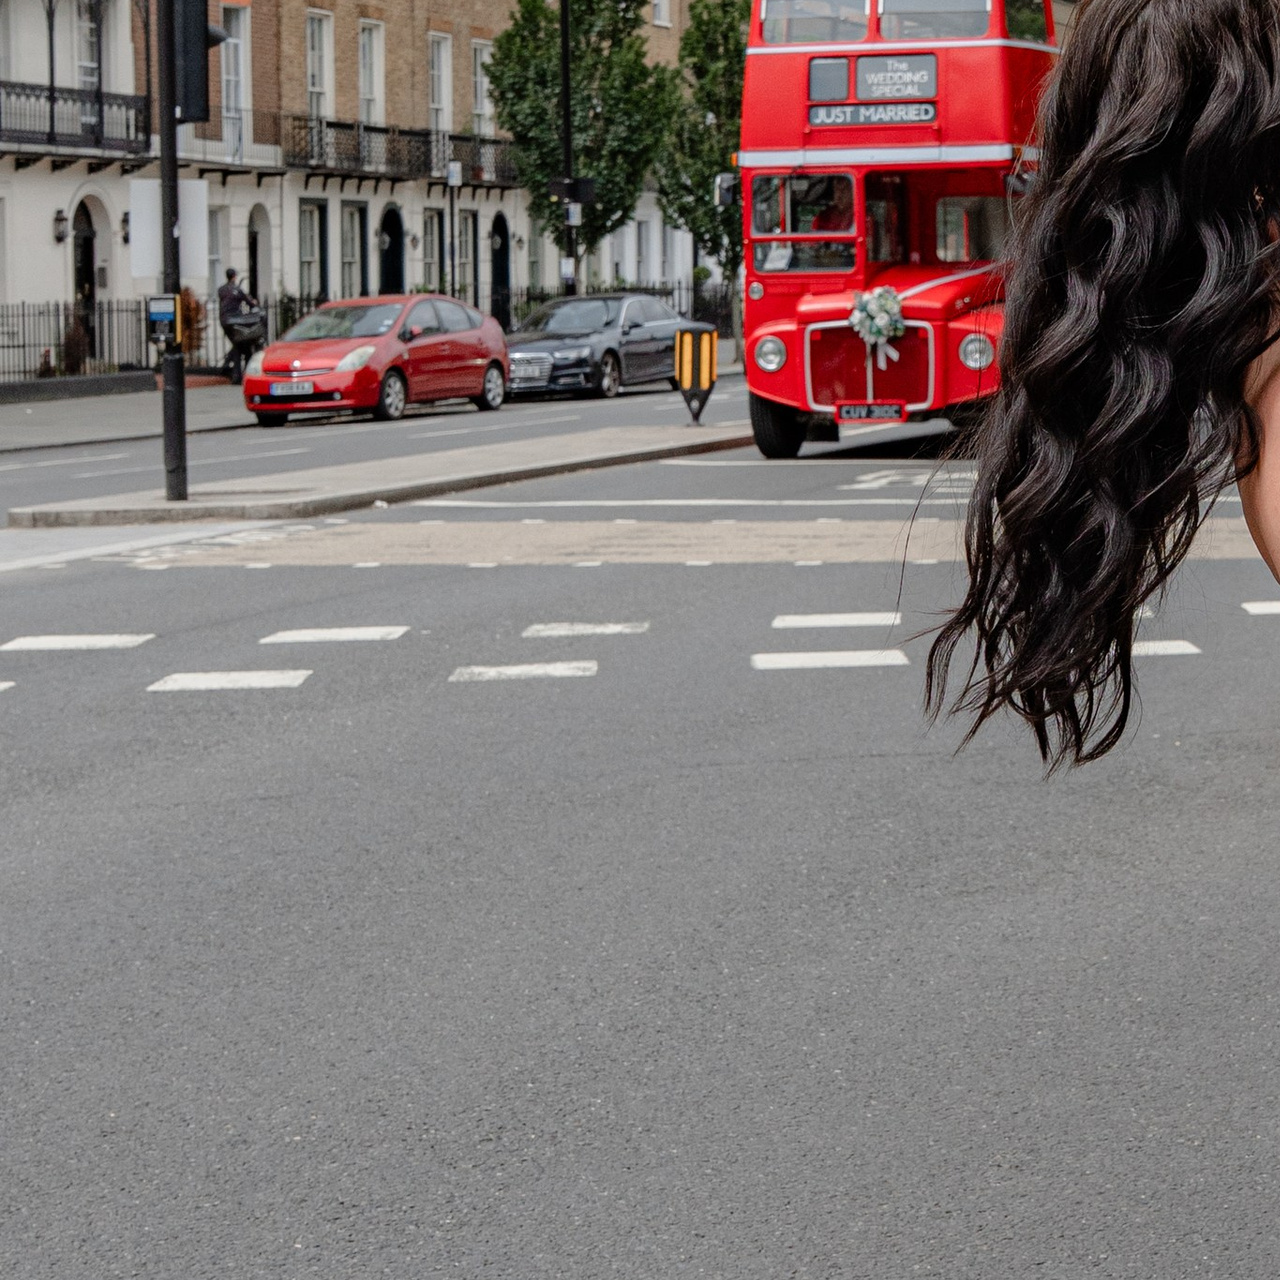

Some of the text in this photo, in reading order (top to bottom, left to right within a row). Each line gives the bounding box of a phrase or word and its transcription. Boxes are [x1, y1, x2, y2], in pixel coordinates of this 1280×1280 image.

[886, 59, 909, 71] The
[865, 71, 929, 85] WEDDING
[870, 84, 921, 97] SPECIAL
[815, 106, 854, 124] JUST
[859, 103, 935, 122] MARRIED
